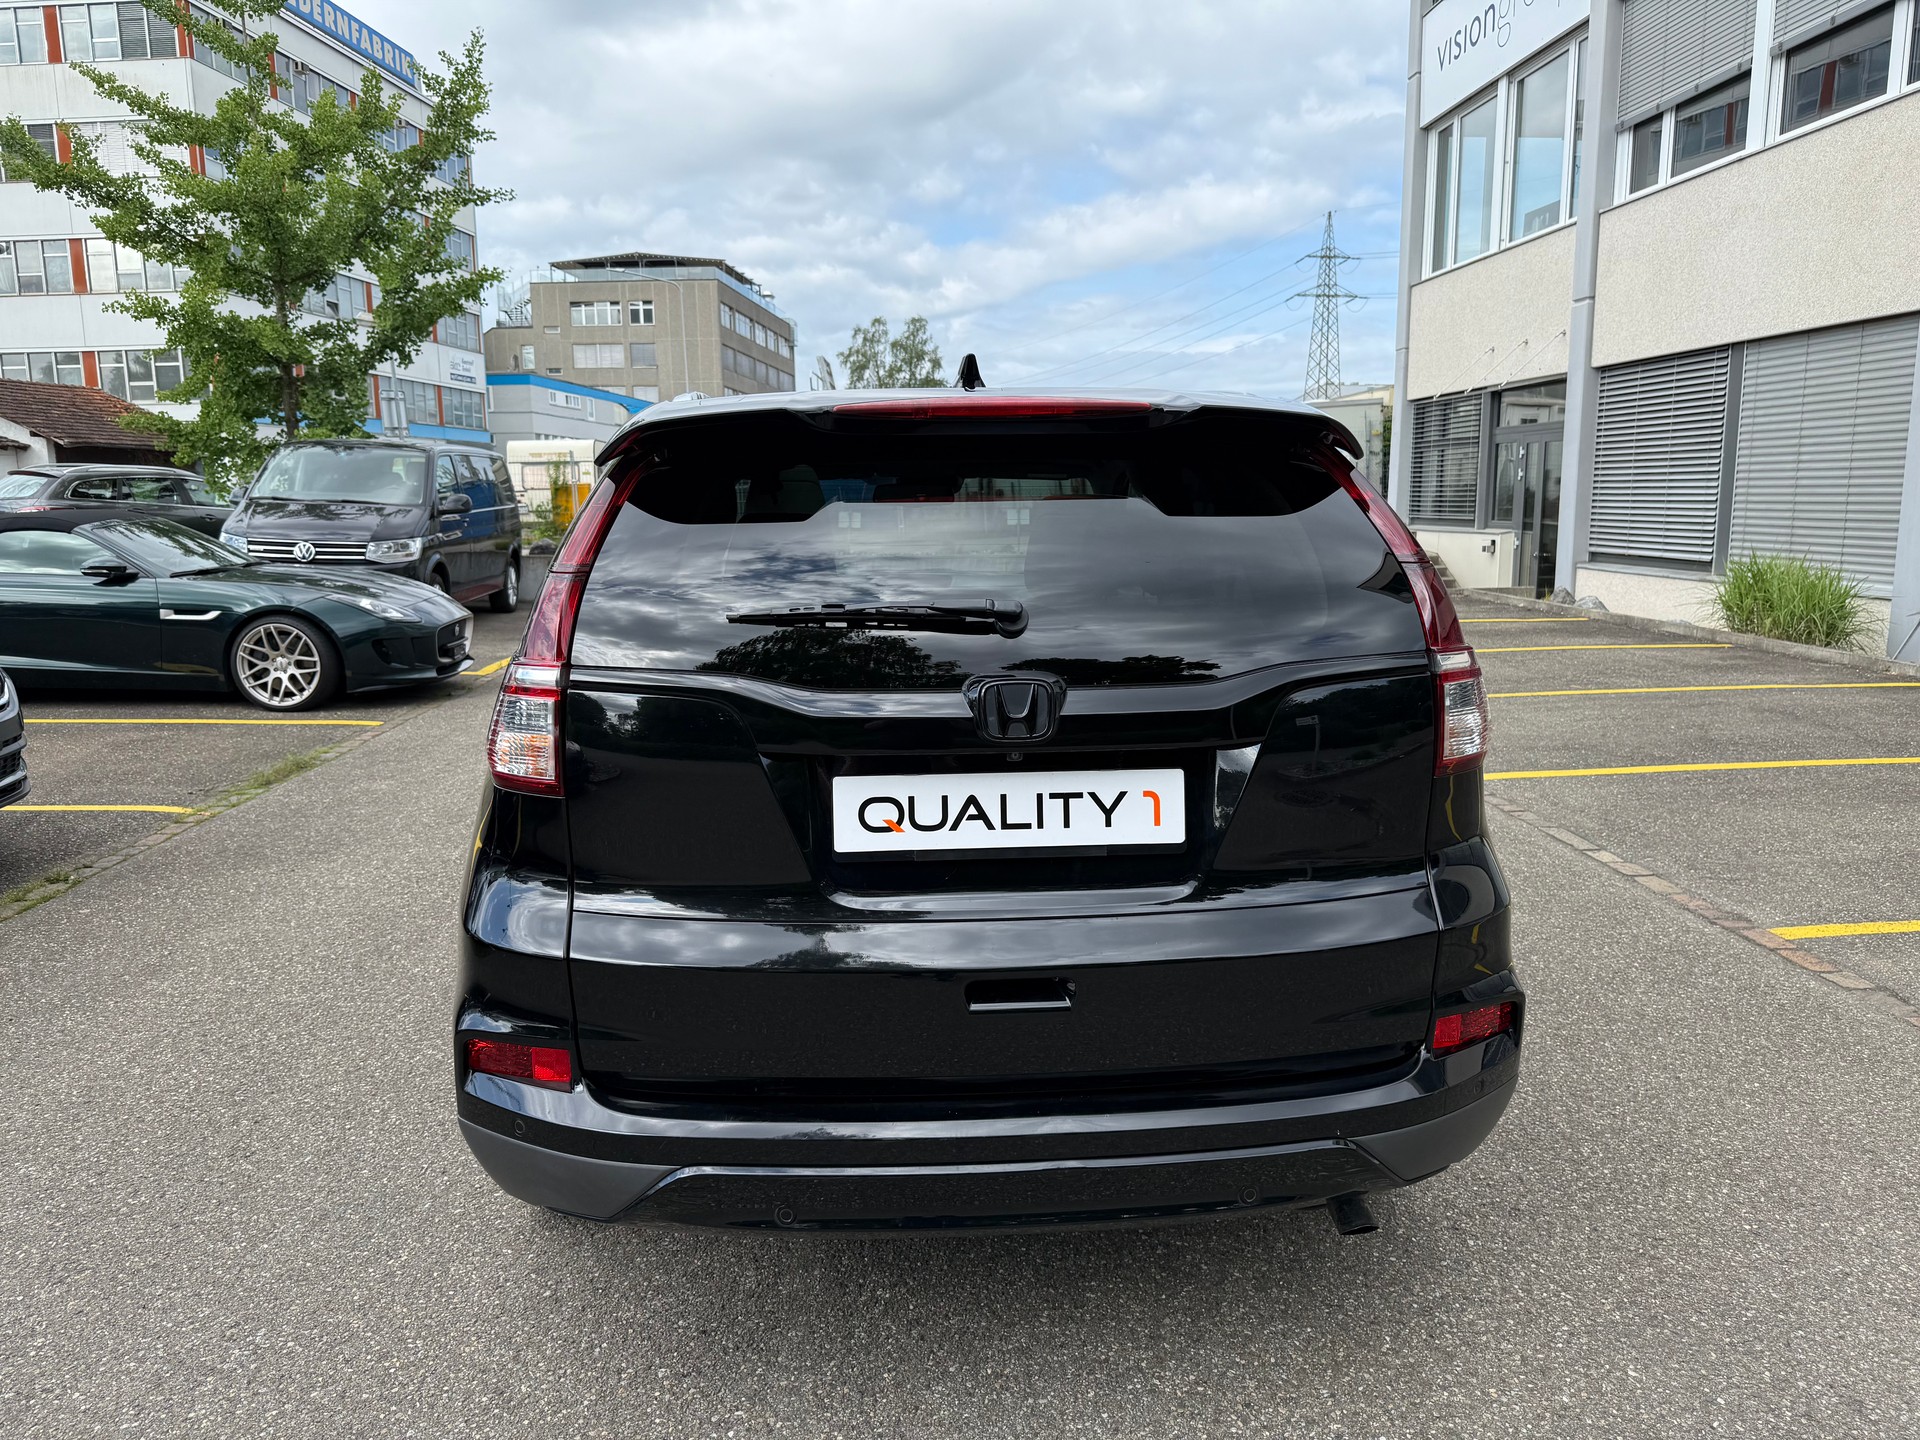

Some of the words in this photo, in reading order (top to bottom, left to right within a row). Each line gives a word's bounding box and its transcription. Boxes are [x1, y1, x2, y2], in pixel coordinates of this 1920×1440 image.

[287, 0, 413, 79] DERNFABRIK
[858, 790, 1129, 833] QUALITY
[1142, 790, 1161, 827] 1
